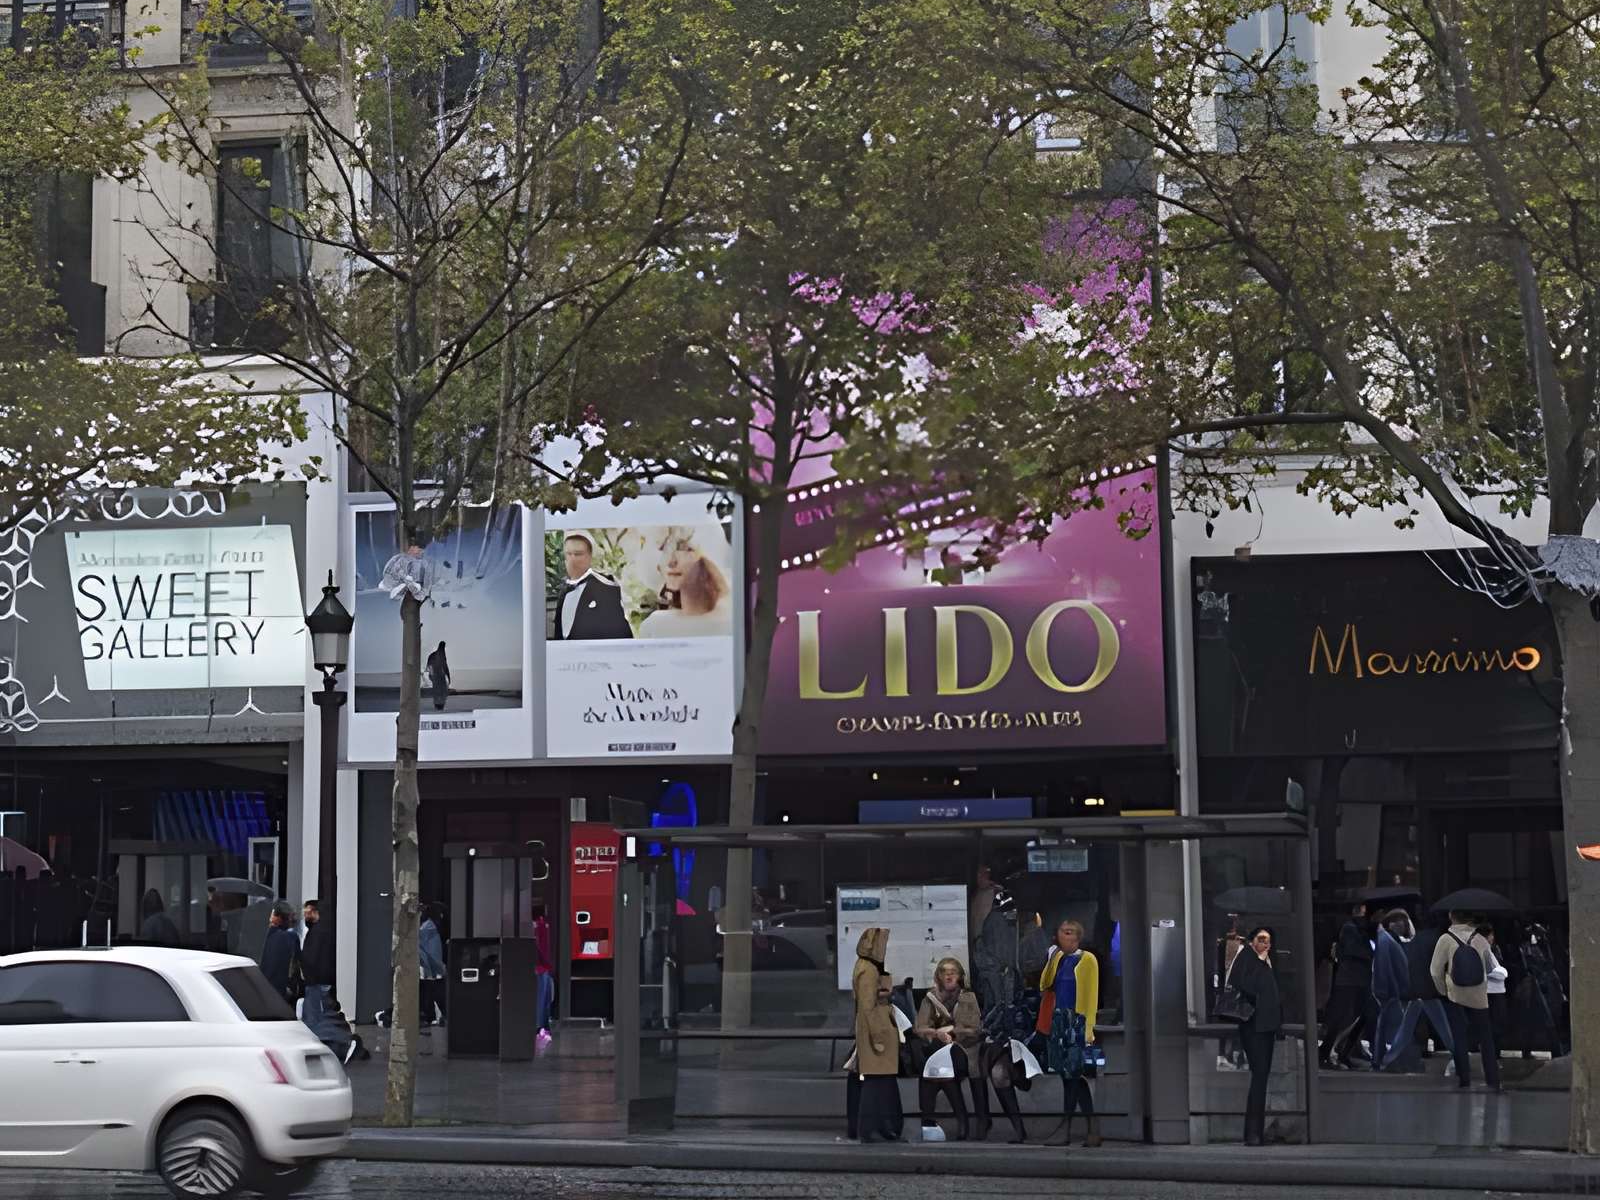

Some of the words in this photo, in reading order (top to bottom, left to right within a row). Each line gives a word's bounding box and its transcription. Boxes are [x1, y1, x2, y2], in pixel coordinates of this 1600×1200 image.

[76, 570, 265, 621] SWEET
[79, 620, 265, 660] GALLERY
[797, 600, 1120, 699] LIDO
